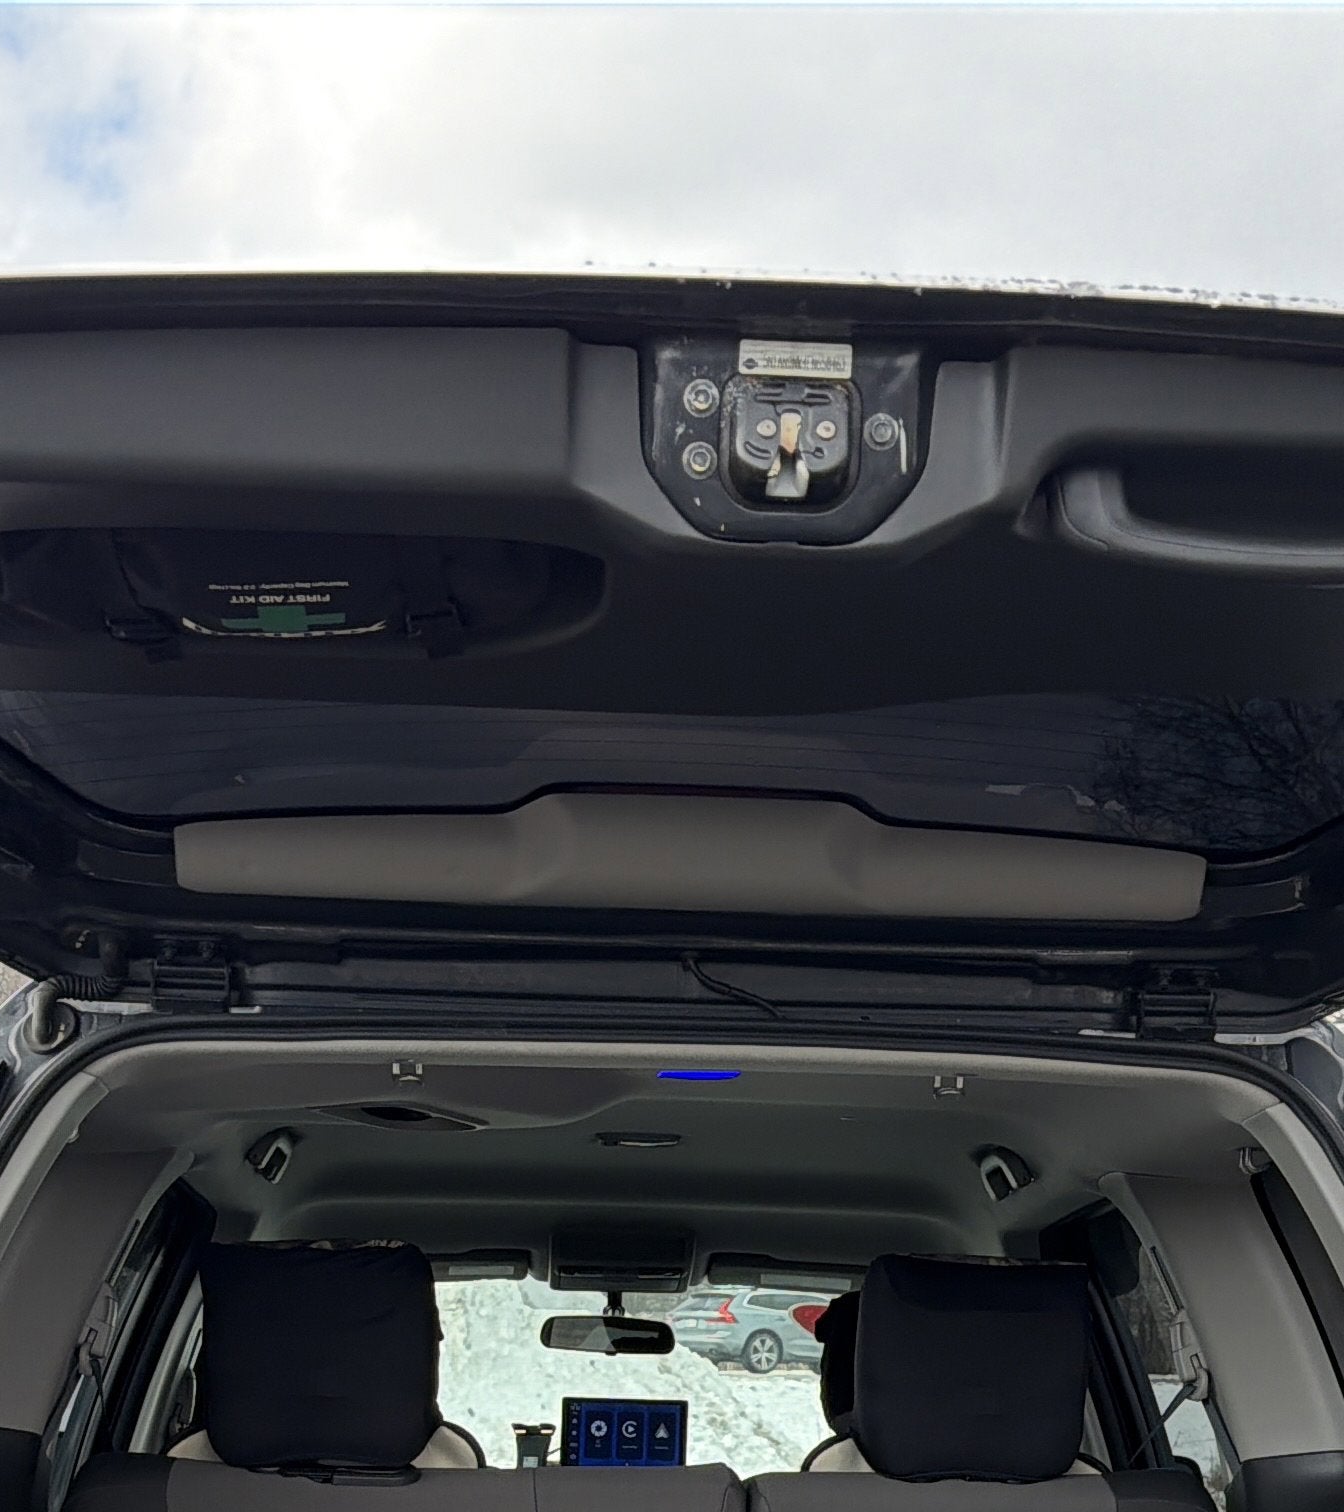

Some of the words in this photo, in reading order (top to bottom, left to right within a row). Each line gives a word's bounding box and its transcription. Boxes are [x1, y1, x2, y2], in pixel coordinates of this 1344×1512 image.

[230, 595, 255, 603] KIT
[258, 595, 285, 603] AID
[287, 594, 331, 603] FIRST
